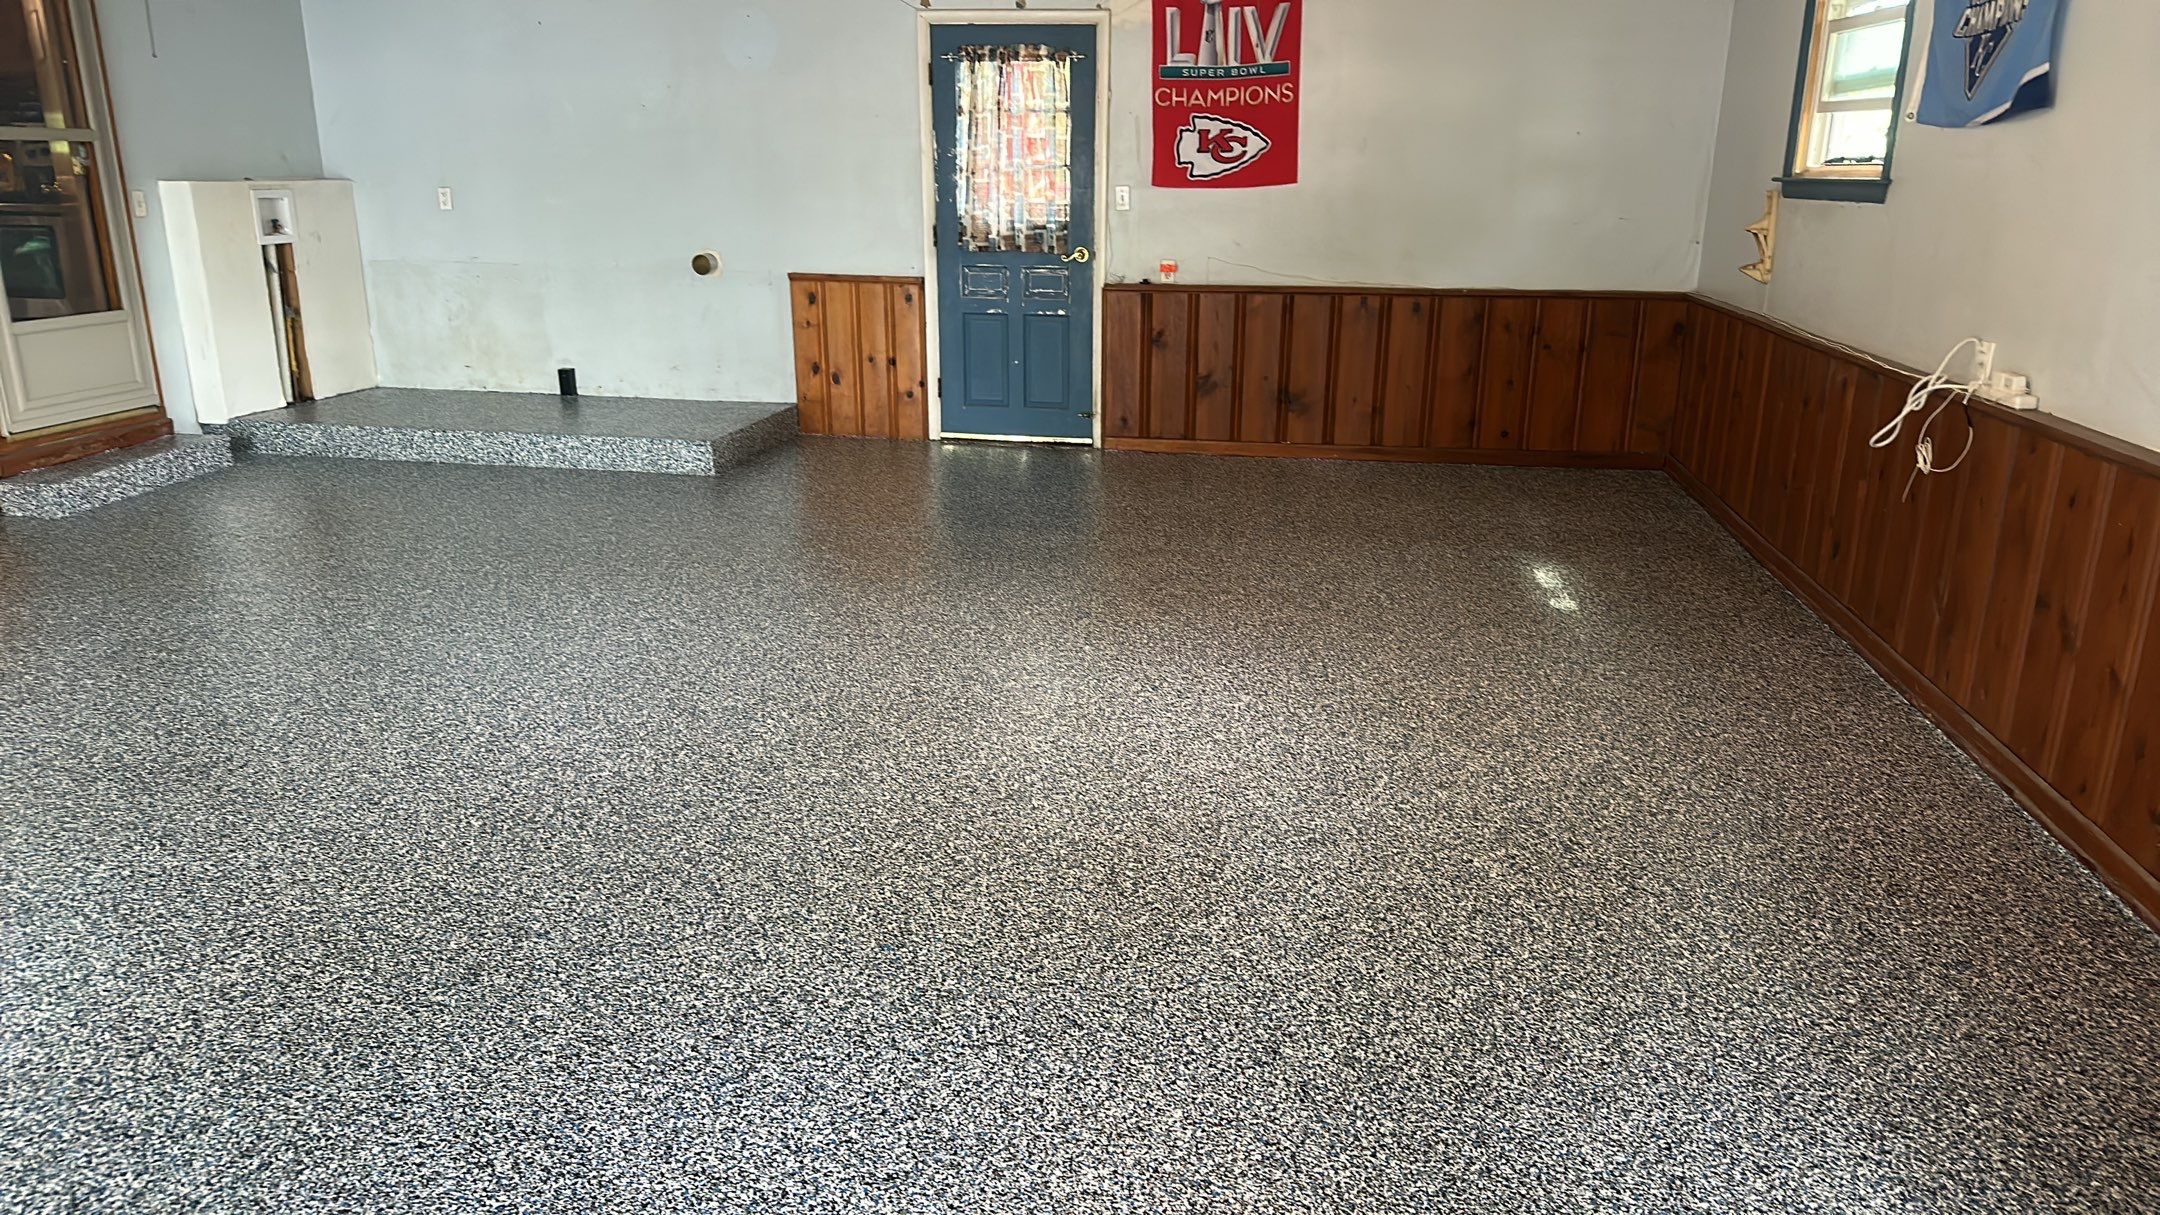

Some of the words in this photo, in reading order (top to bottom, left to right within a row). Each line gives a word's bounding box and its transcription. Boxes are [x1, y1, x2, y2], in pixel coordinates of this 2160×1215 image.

[1182, 67, 1225, 77] SUPER
[1231, 66, 1266, 76] BOWL
[1154, 82, 1294, 108] CHAMPIONS
[1196, 128, 1248, 164] KC
